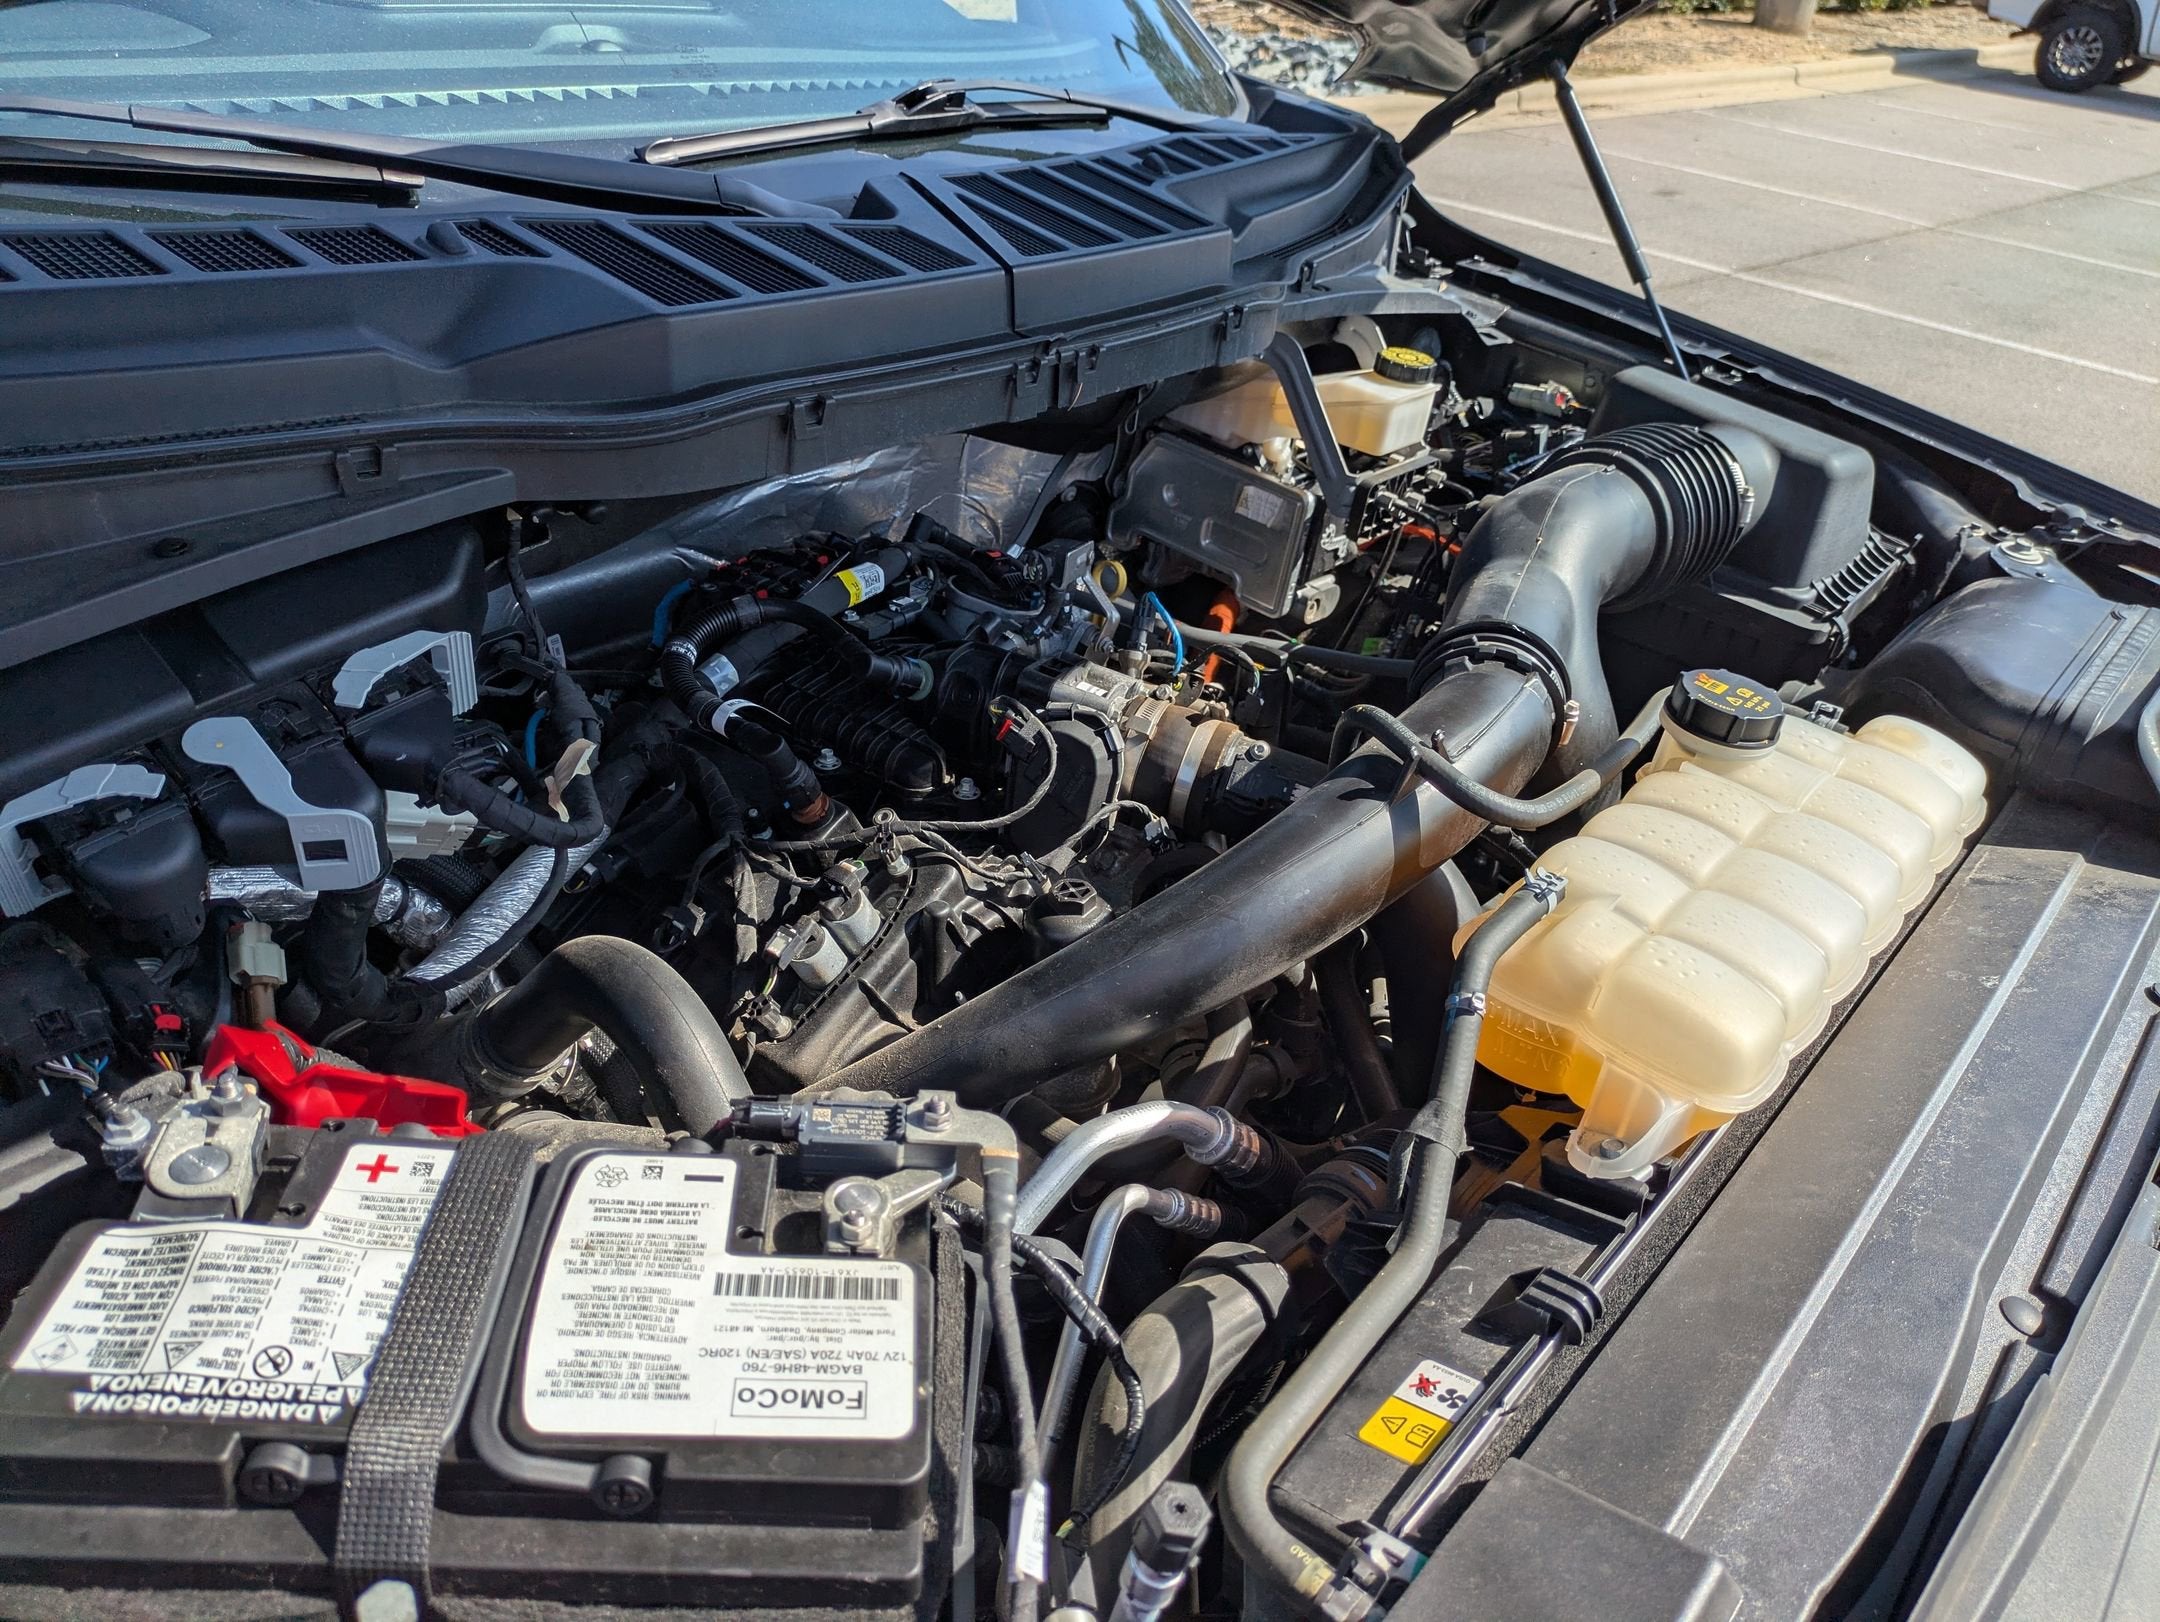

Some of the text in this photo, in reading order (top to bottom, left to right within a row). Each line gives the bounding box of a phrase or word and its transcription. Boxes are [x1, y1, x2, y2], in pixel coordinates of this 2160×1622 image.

[1501, 1008, 1560, 1047] MAX
[1493, 1034, 1554, 1072] MIN
[304, 1296, 332, 1306] FLAMAS
[188, 1304, 260, 1317] ÁCIDO SULFÚRICO
[298, 1304, 329, 1314] CHISPAS
[215, 1320, 242, 1328] SEVERE
[244, 1321, 254, 1329] OR
[290, 1316, 324, 1327] SMOKING
[292, 1326, 320, 1337] FLAMES
[714, 1324, 740, 1332] 48121
[849, 1328, 873, 1336] Motor
[876, 1329, 895, 1337] Ford
[169, 1330, 250, 1339] CAN CAUSE BLINDNESS
[288, 1337, 317, 1347] SPARKS
[222, 1347, 244, 1358] ACID
[698, 1347, 906, 1360] 12V 70Ah 720A (SAE/EN) 120RC
[196, 1358, 239, 1371] SULFURIC
[302, 1361, 314, 1371] NO
[742, 1362, 863, 1375] BAGM-48H6-760
[109, 1374, 344, 1404] PELIGRO/VENENO
[737, 1387, 864, 1410] FoMoCo
[91, 1392, 316, 1422] DANGER/POISON
[1290, 1544, 1312, 1565] RAD
